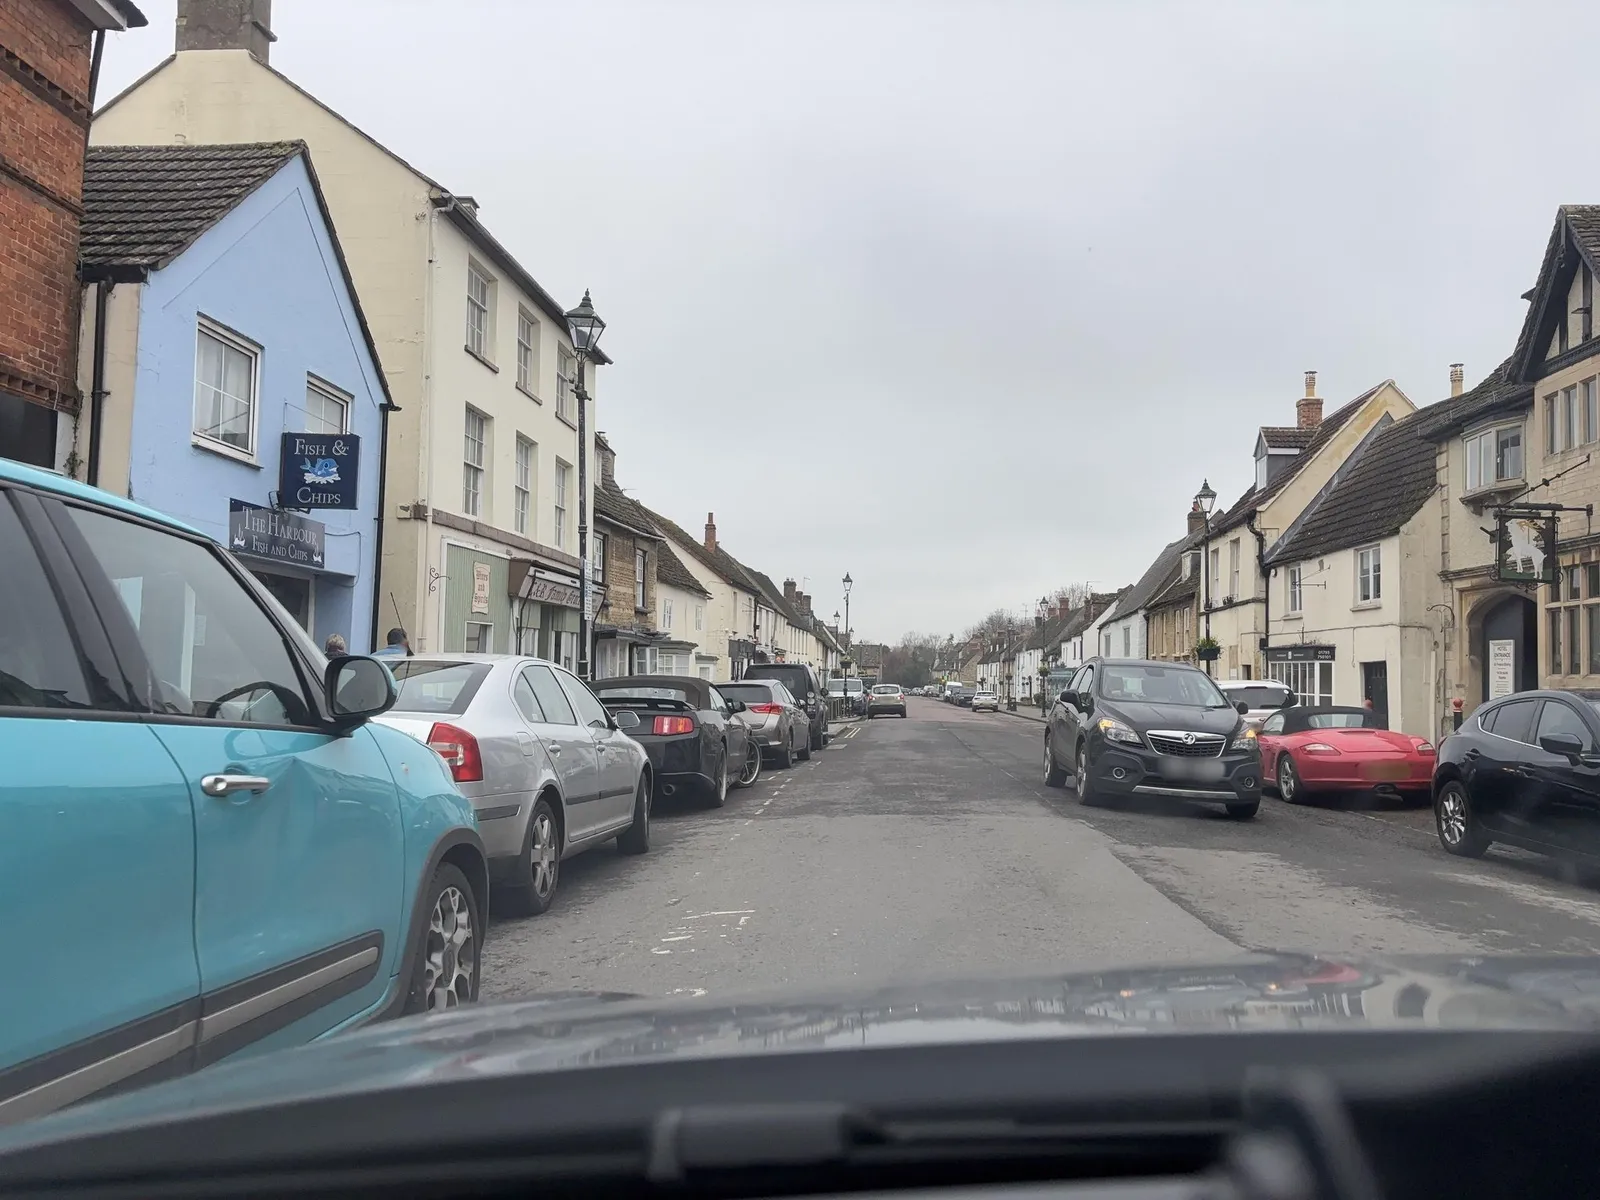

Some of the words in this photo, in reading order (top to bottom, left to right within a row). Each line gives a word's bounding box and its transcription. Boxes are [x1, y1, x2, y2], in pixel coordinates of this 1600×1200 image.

[294, 438, 326, 455] FISH
[332, 439, 349, 456] &
[296, 486, 341, 504] CHIPS
[242, 505, 266, 533] THE
[268, 512, 317, 545] HARBOUR
[252, 534, 268, 553] FISH
[271, 545, 287, 556] AND
[288, 543, 308, 561] CHIPS
